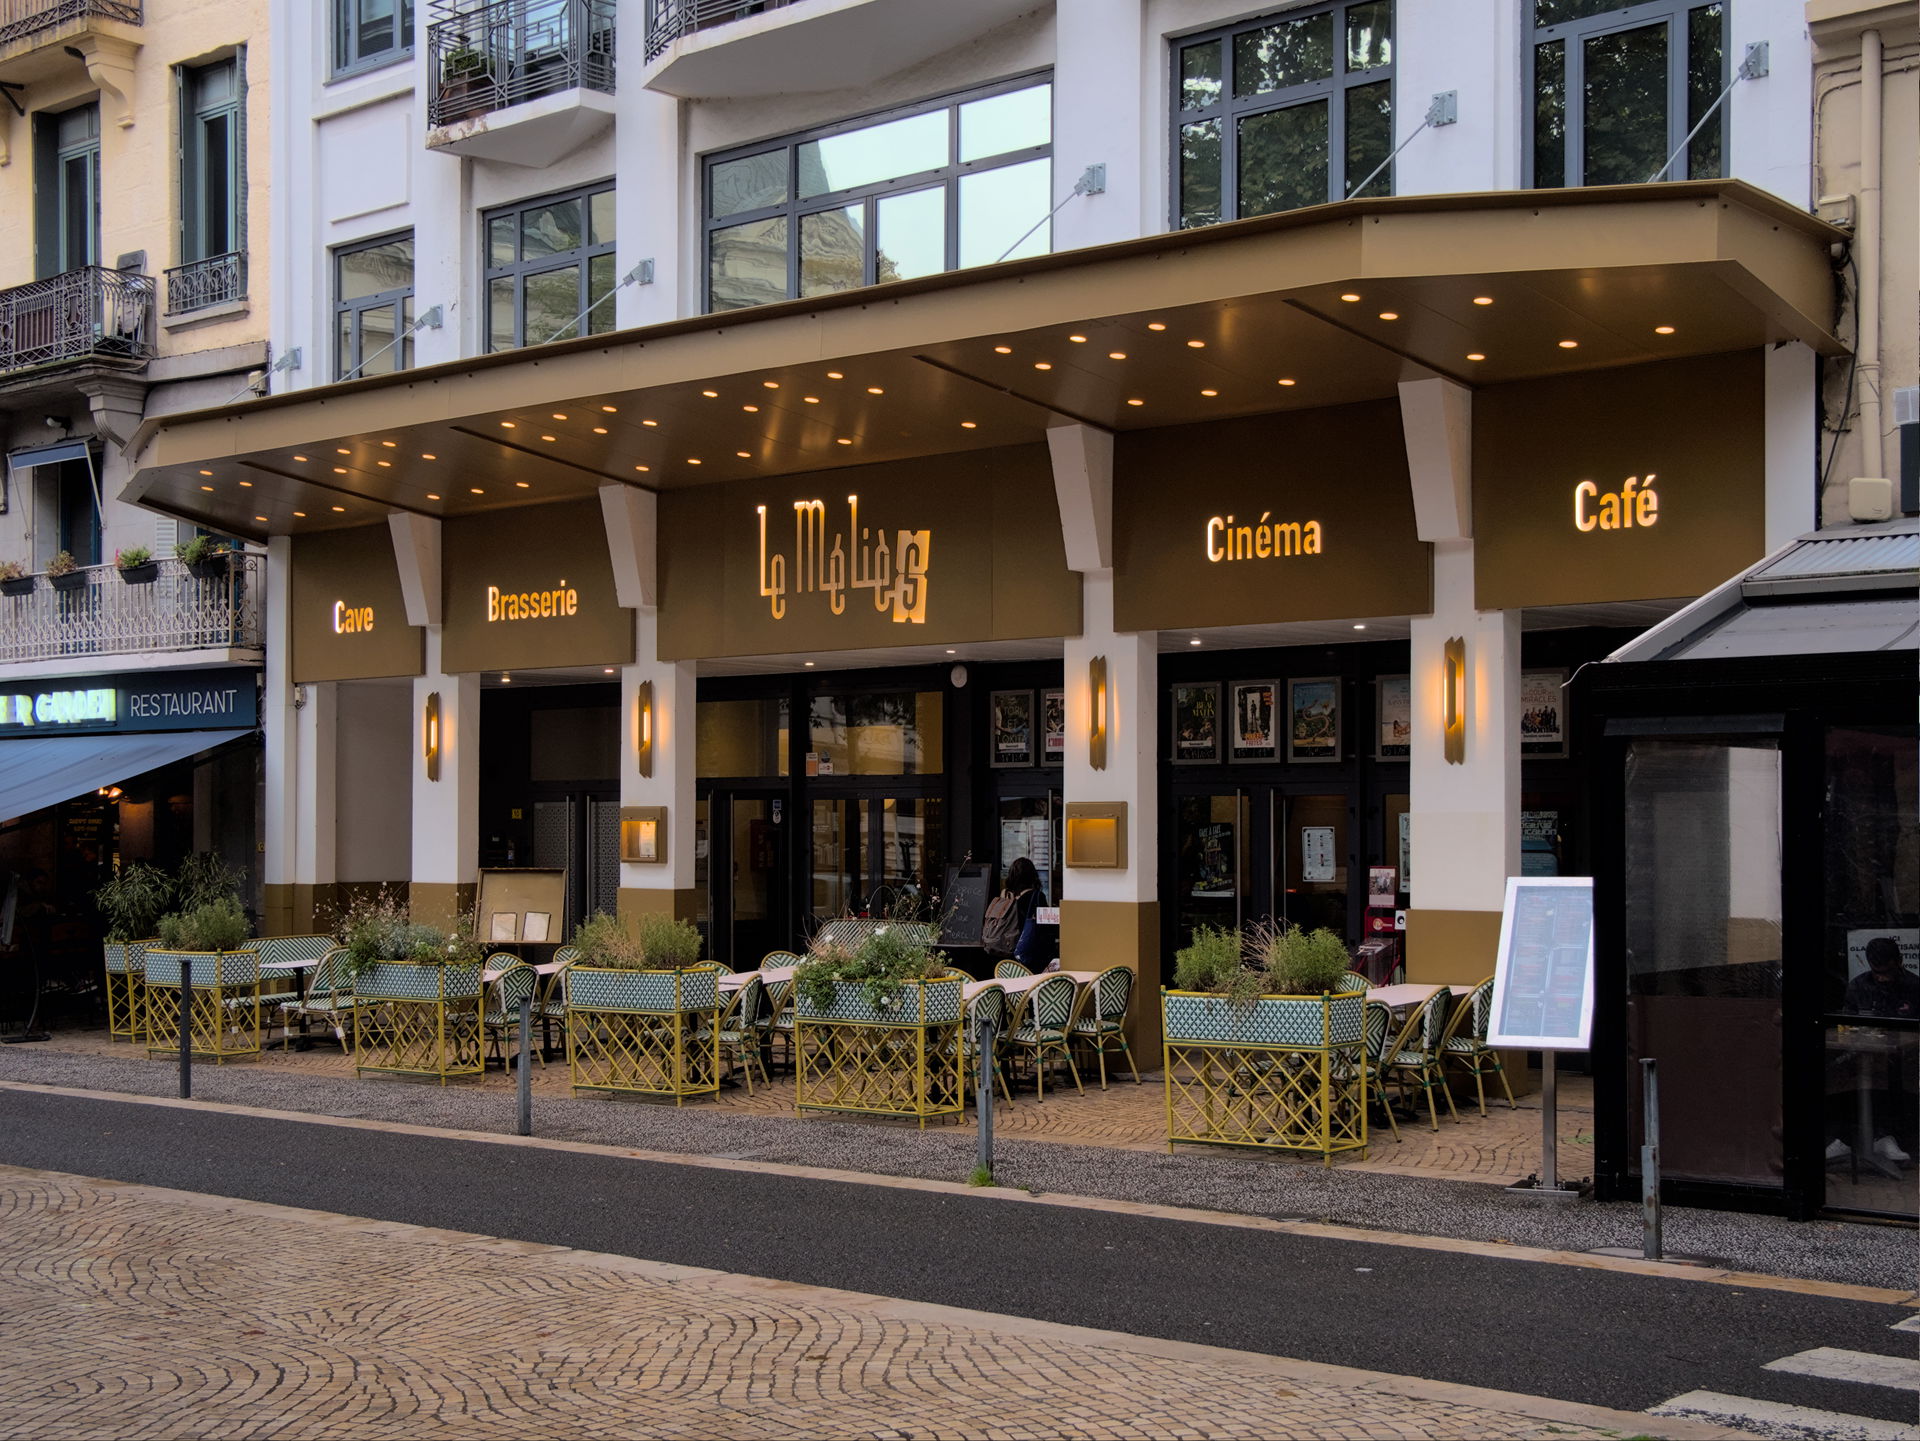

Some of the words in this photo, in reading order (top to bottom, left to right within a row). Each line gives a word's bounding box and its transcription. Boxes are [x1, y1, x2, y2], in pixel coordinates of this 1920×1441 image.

[1575, 474, 1658, 532] Café
[1207, 511, 1321, 562] Cinéma
[333, 600, 374, 634] Cave
[487, 579, 578, 622] Brasserie
[130, 689, 238, 718] RESTAURANT
